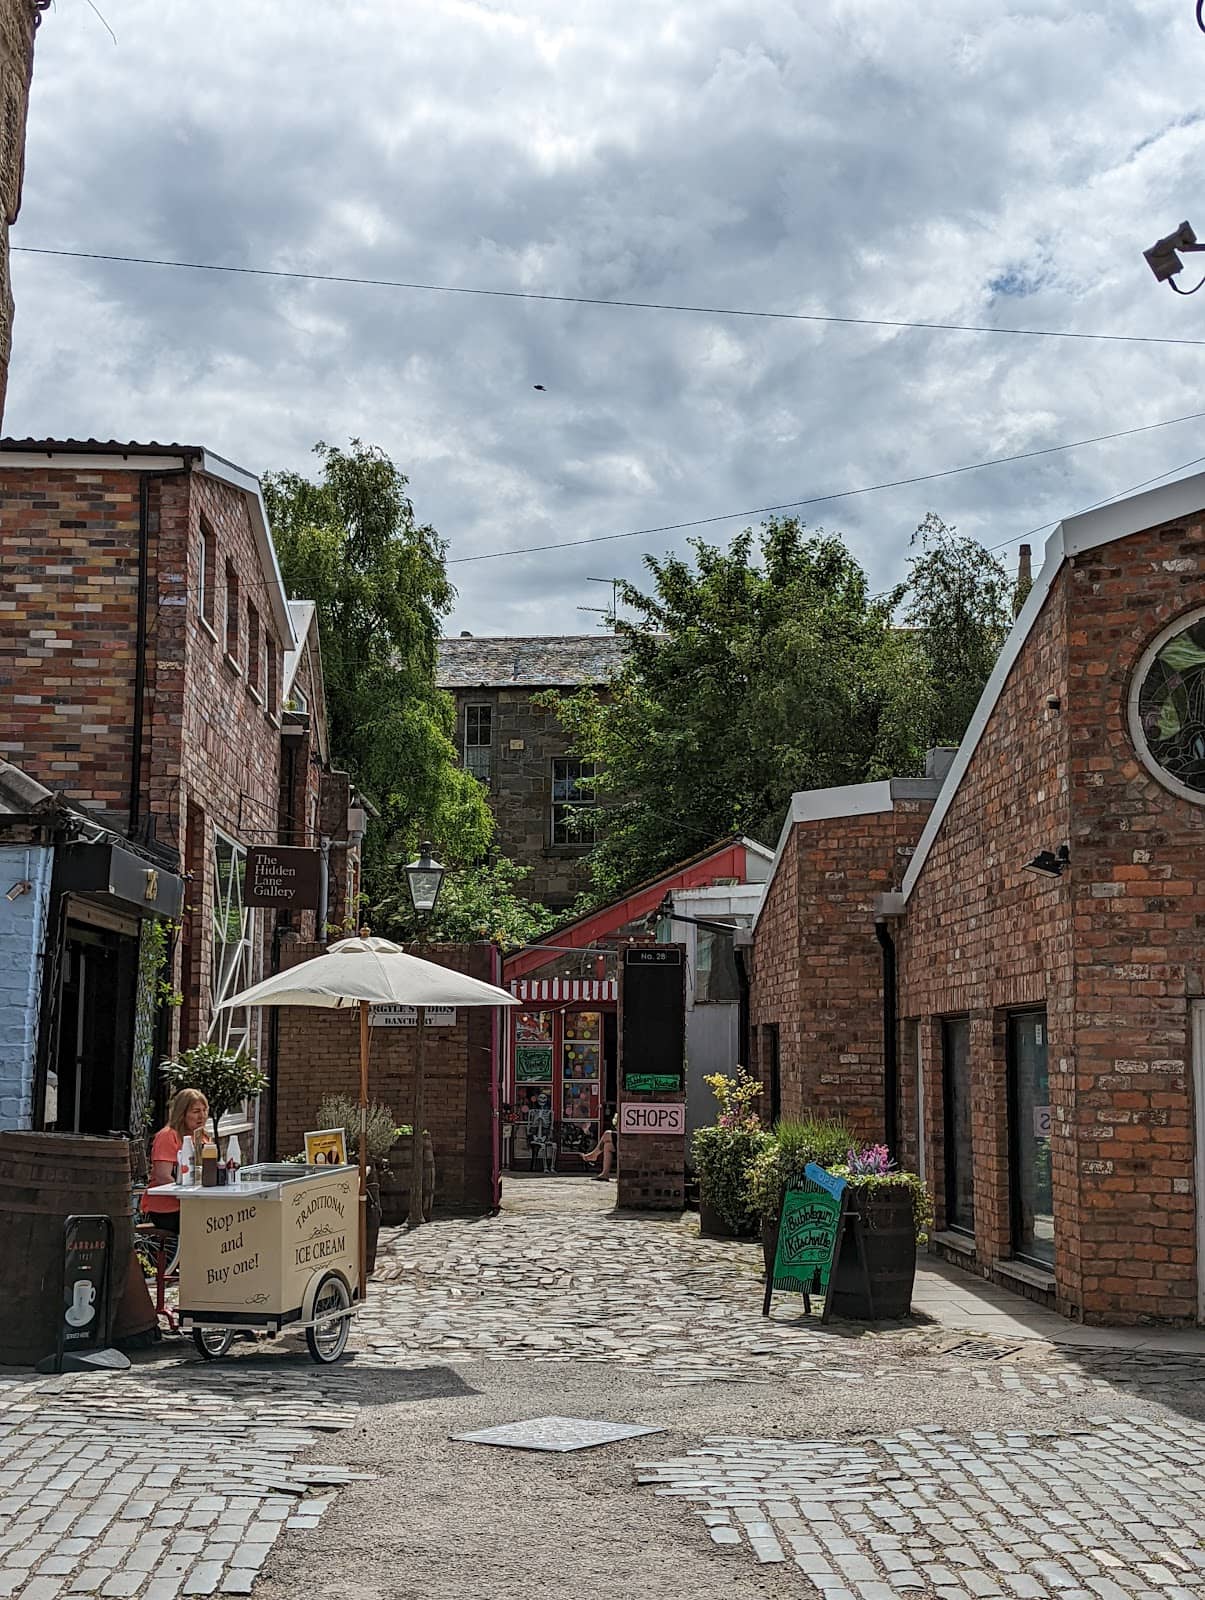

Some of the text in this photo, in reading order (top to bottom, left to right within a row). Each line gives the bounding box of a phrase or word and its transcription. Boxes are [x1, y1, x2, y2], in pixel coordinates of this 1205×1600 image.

[254, 854, 278, 865] The
[255, 864, 296, 876] Hidden
[254, 875, 283, 886] Lane
[253, 886, 296, 900] Gallery
[640, 952, 655, 961] No.
[407, 1005, 455, 1013] SDIOS
[625, 1109, 679, 1128] SHOPS
[206, 1205, 257, 1234] Stop me
[295, 1195, 345, 1229] TRADITIONAL
[787, 1204, 834, 1232] Bubblegum
[220, 1231, 244, 1254] and
[295, 1235, 345, 1265] ICE CREAM
[786, 1231, 832, 1257] Kitschville
[206, 1252, 259, 1285] Buy one!
